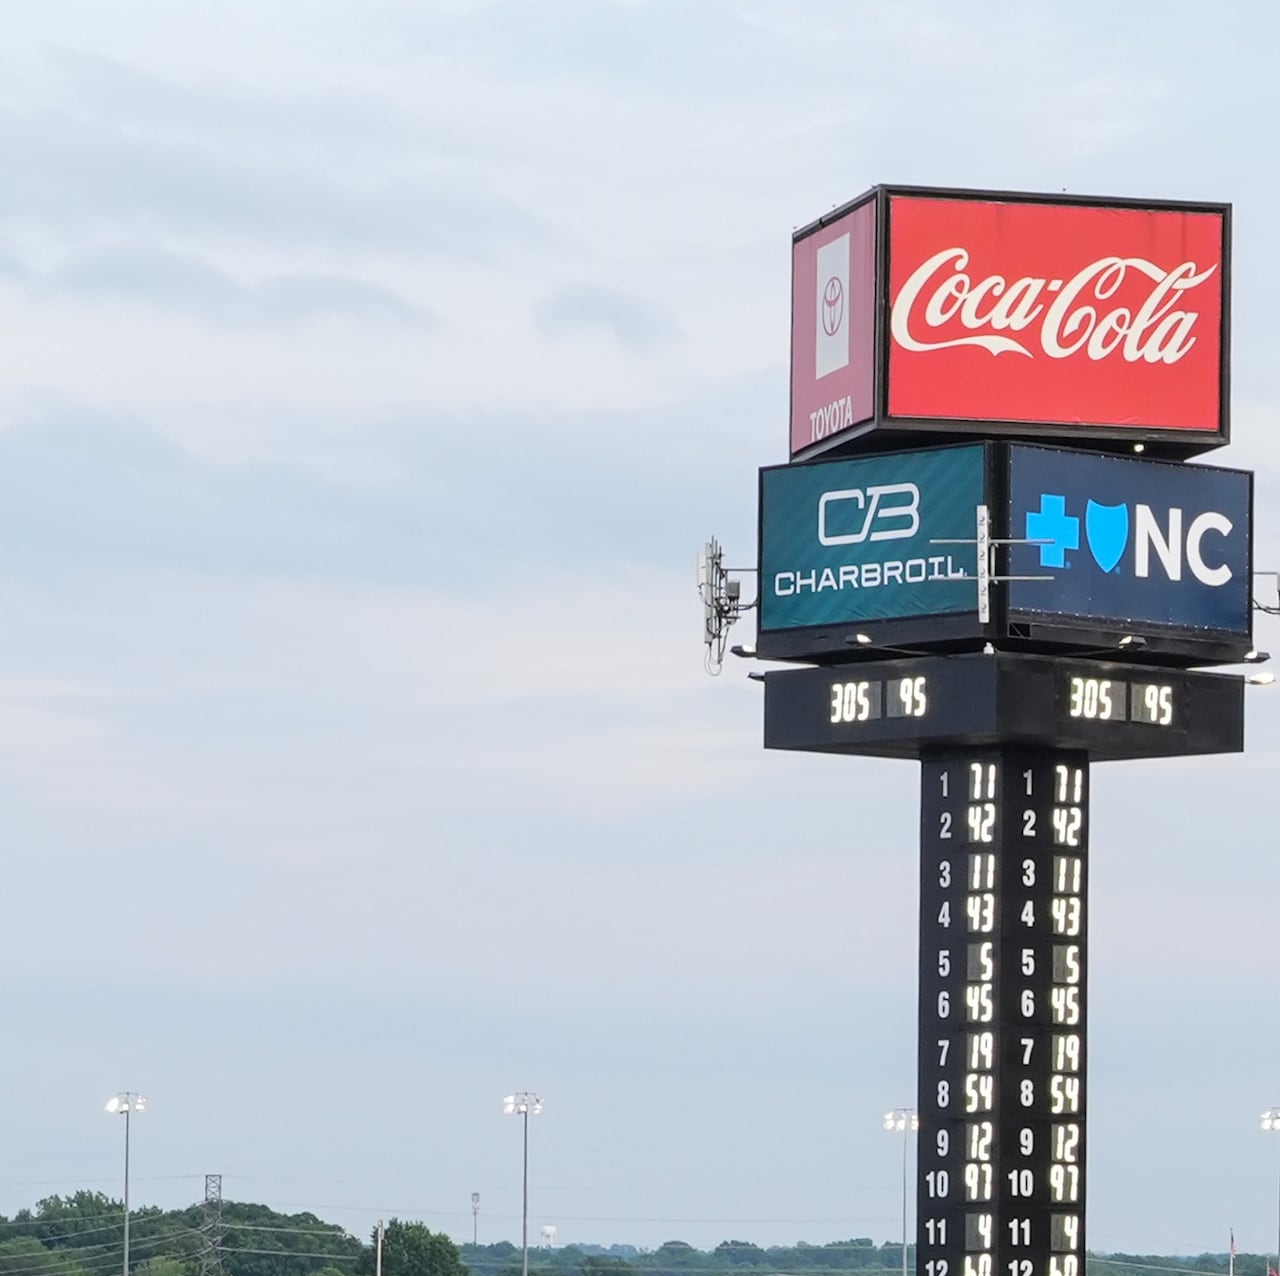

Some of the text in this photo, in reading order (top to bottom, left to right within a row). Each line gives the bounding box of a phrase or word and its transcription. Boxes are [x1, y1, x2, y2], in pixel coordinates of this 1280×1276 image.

[890, 246, 1218, 365] Coca-Cola
[808, 395, 854, 441] TOYOTA
[1134, 504, 1234, 587] NC
[774, 555, 966, 597] CHARBROIL
[829, 682, 872, 723] 305
[900, 677, 927, 718] 95
[1069, 679, 1113, 721] 305
[1144, 683, 1174, 724] 95
[940, 763, 996, 800] 1 71
[1023, 765, 1082, 803] 1 71
[939, 803, 996, 843] 2 42
[1022, 807, 1082, 846] 2 42
[939, 854, 995, 889] 3 11
[1022, 858, 1081, 893] 3 11
[938, 893, 995, 933] 4 43
[1020, 897, 1081, 936] 4 43
[938, 942, 993, 981] 5 5
[1021, 945, 1080, 984] 5 5
[938, 983, 993, 1022] 6 45
[1021, 986, 1079, 1025] 6 45
[937, 1032, 993, 1069] 7 19
[1020, 1034, 1080, 1071] 7 19
[965, 1073, 993, 1113] 54
[1051, 1075, 1079, 1114] 54
[936, 1122, 993, 1161] 9 12
[1019, 1124, 1079, 1162] 9 12
[925, 1163, 992, 1200] 10 97
[1007, 1164, 1079, 1201] 10 97
[925, 1214, 992, 1249] 11 4
[1008, 1215, 1079, 1250] 11 4
